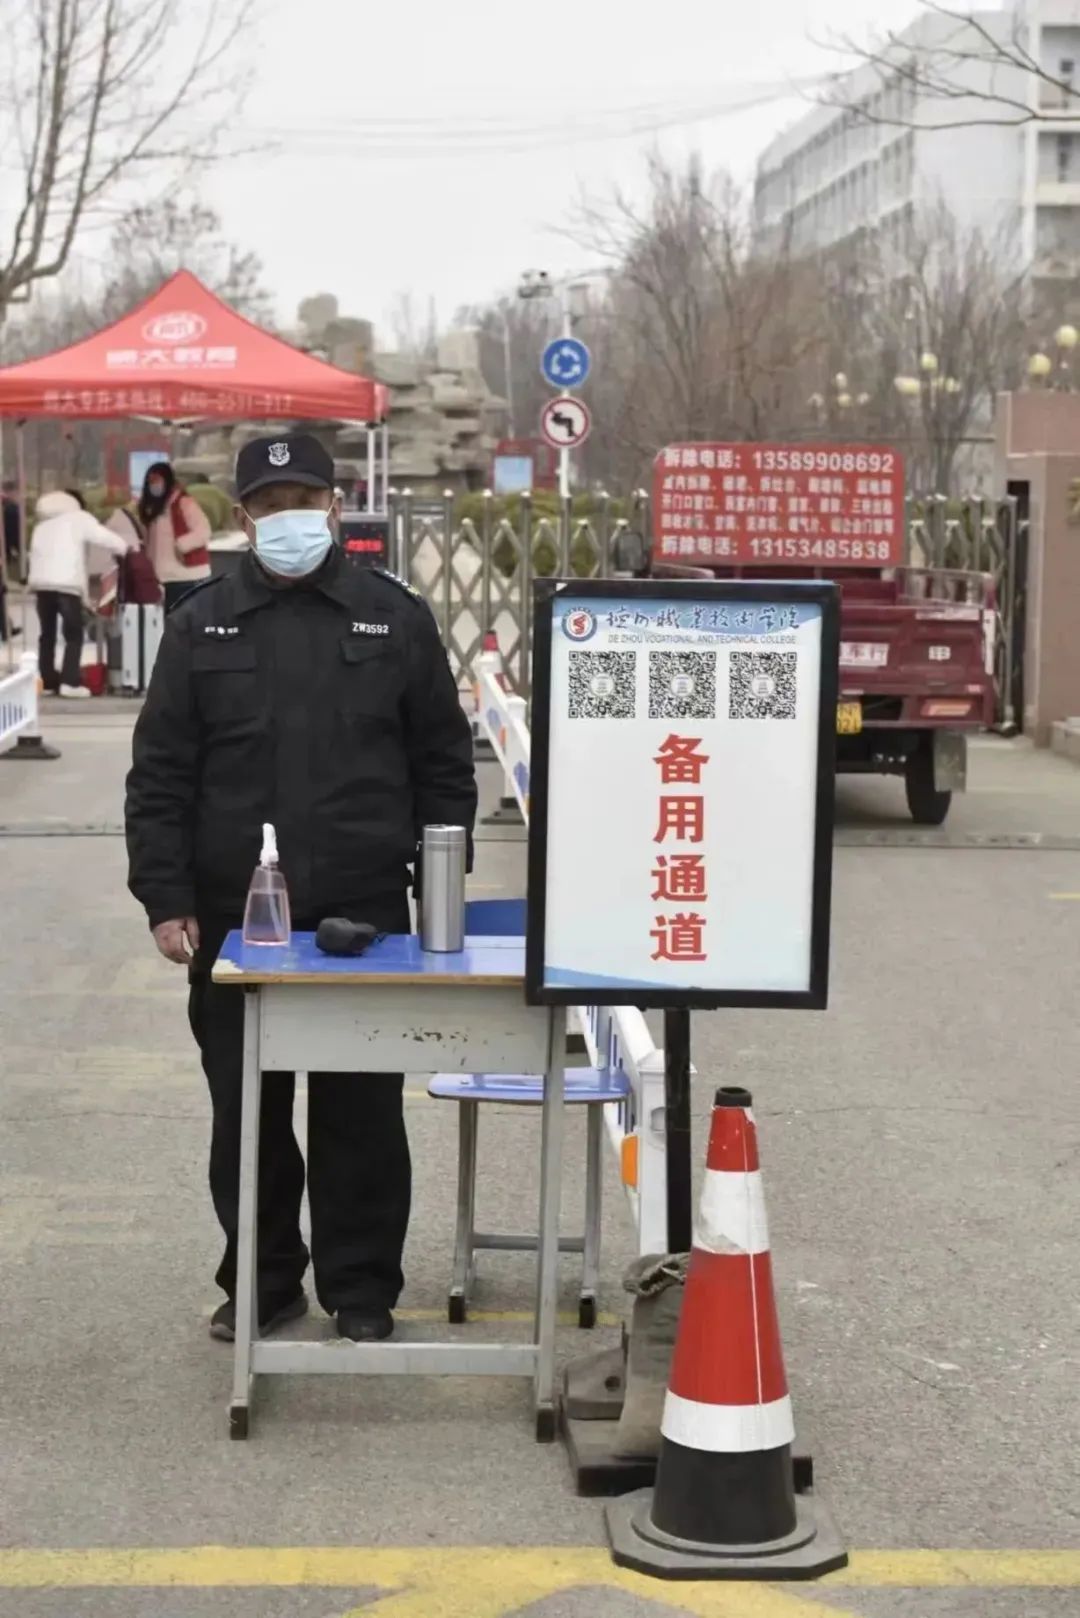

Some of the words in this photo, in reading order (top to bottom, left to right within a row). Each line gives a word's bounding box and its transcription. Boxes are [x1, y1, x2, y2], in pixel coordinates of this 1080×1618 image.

[352, 622, 389, 634] ZW3592
[620, 634, 643, 644] ZHOU
[644, 634, 693, 645] VOCATIONAL
[698, 635, 713, 645] AND
[714, 635, 760, 645] TECHNICAL
[760, 635, 797, 645] COLLEGE
[650, 734, 710, 961] 备用通道
